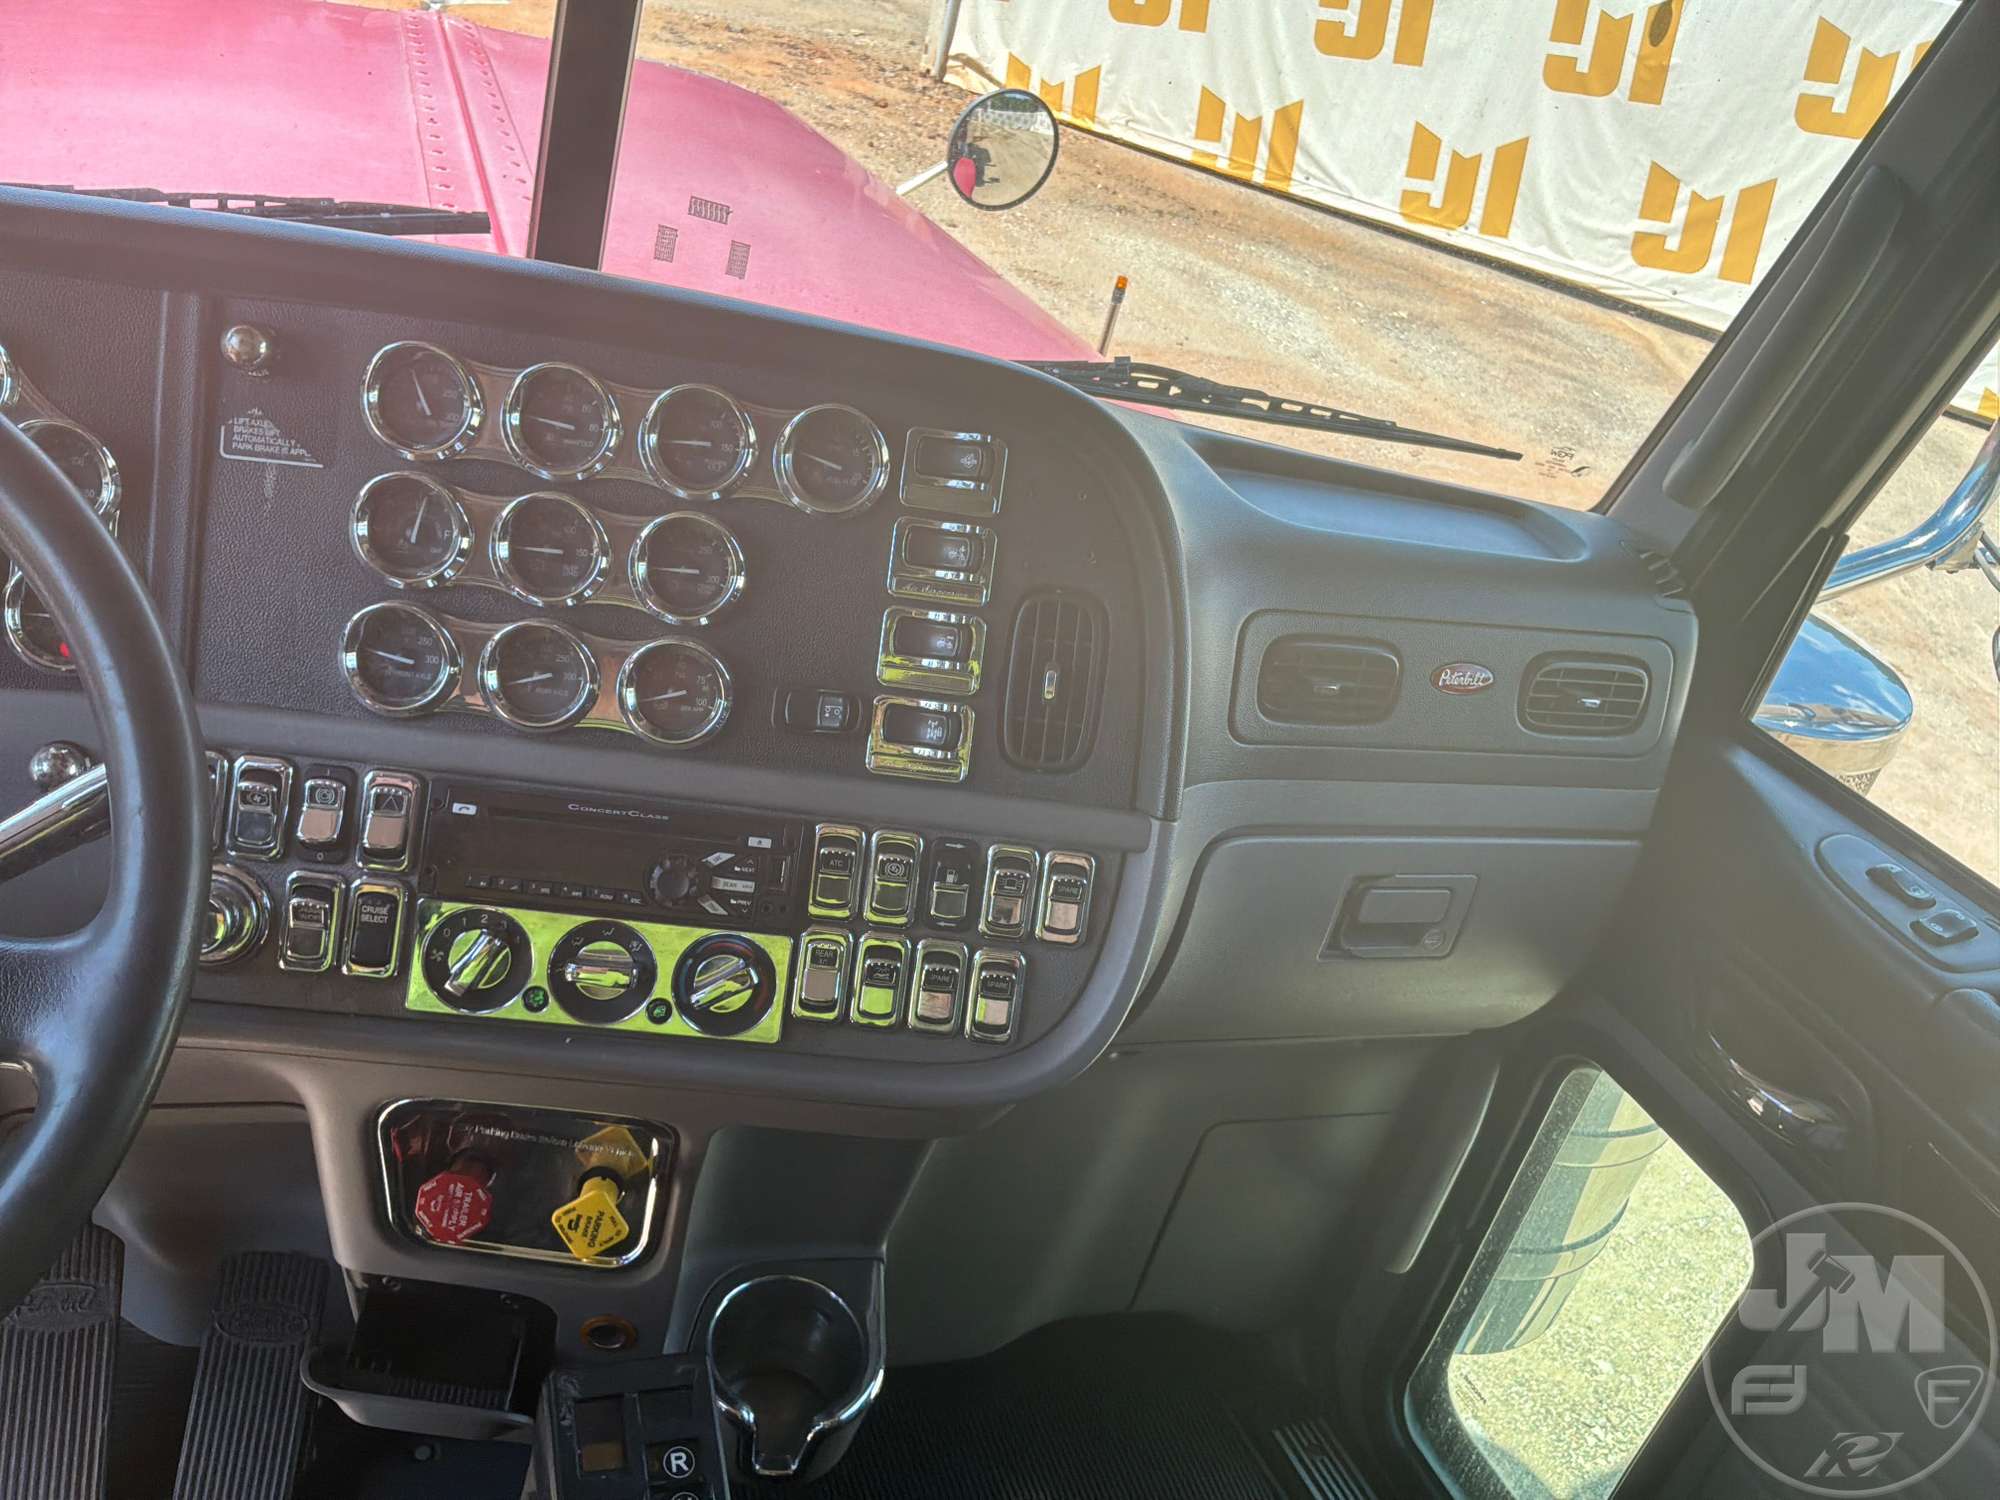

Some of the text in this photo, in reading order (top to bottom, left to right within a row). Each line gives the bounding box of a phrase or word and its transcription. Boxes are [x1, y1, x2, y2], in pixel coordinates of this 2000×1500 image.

[361, 904, 389, 915] CRUISE
[360, 913, 389, 924] SELECT
[481, 914, 488, 924] 2
[587, 1209, 605, 1248] PARKING
[670, 1451, 689, 1474] R
